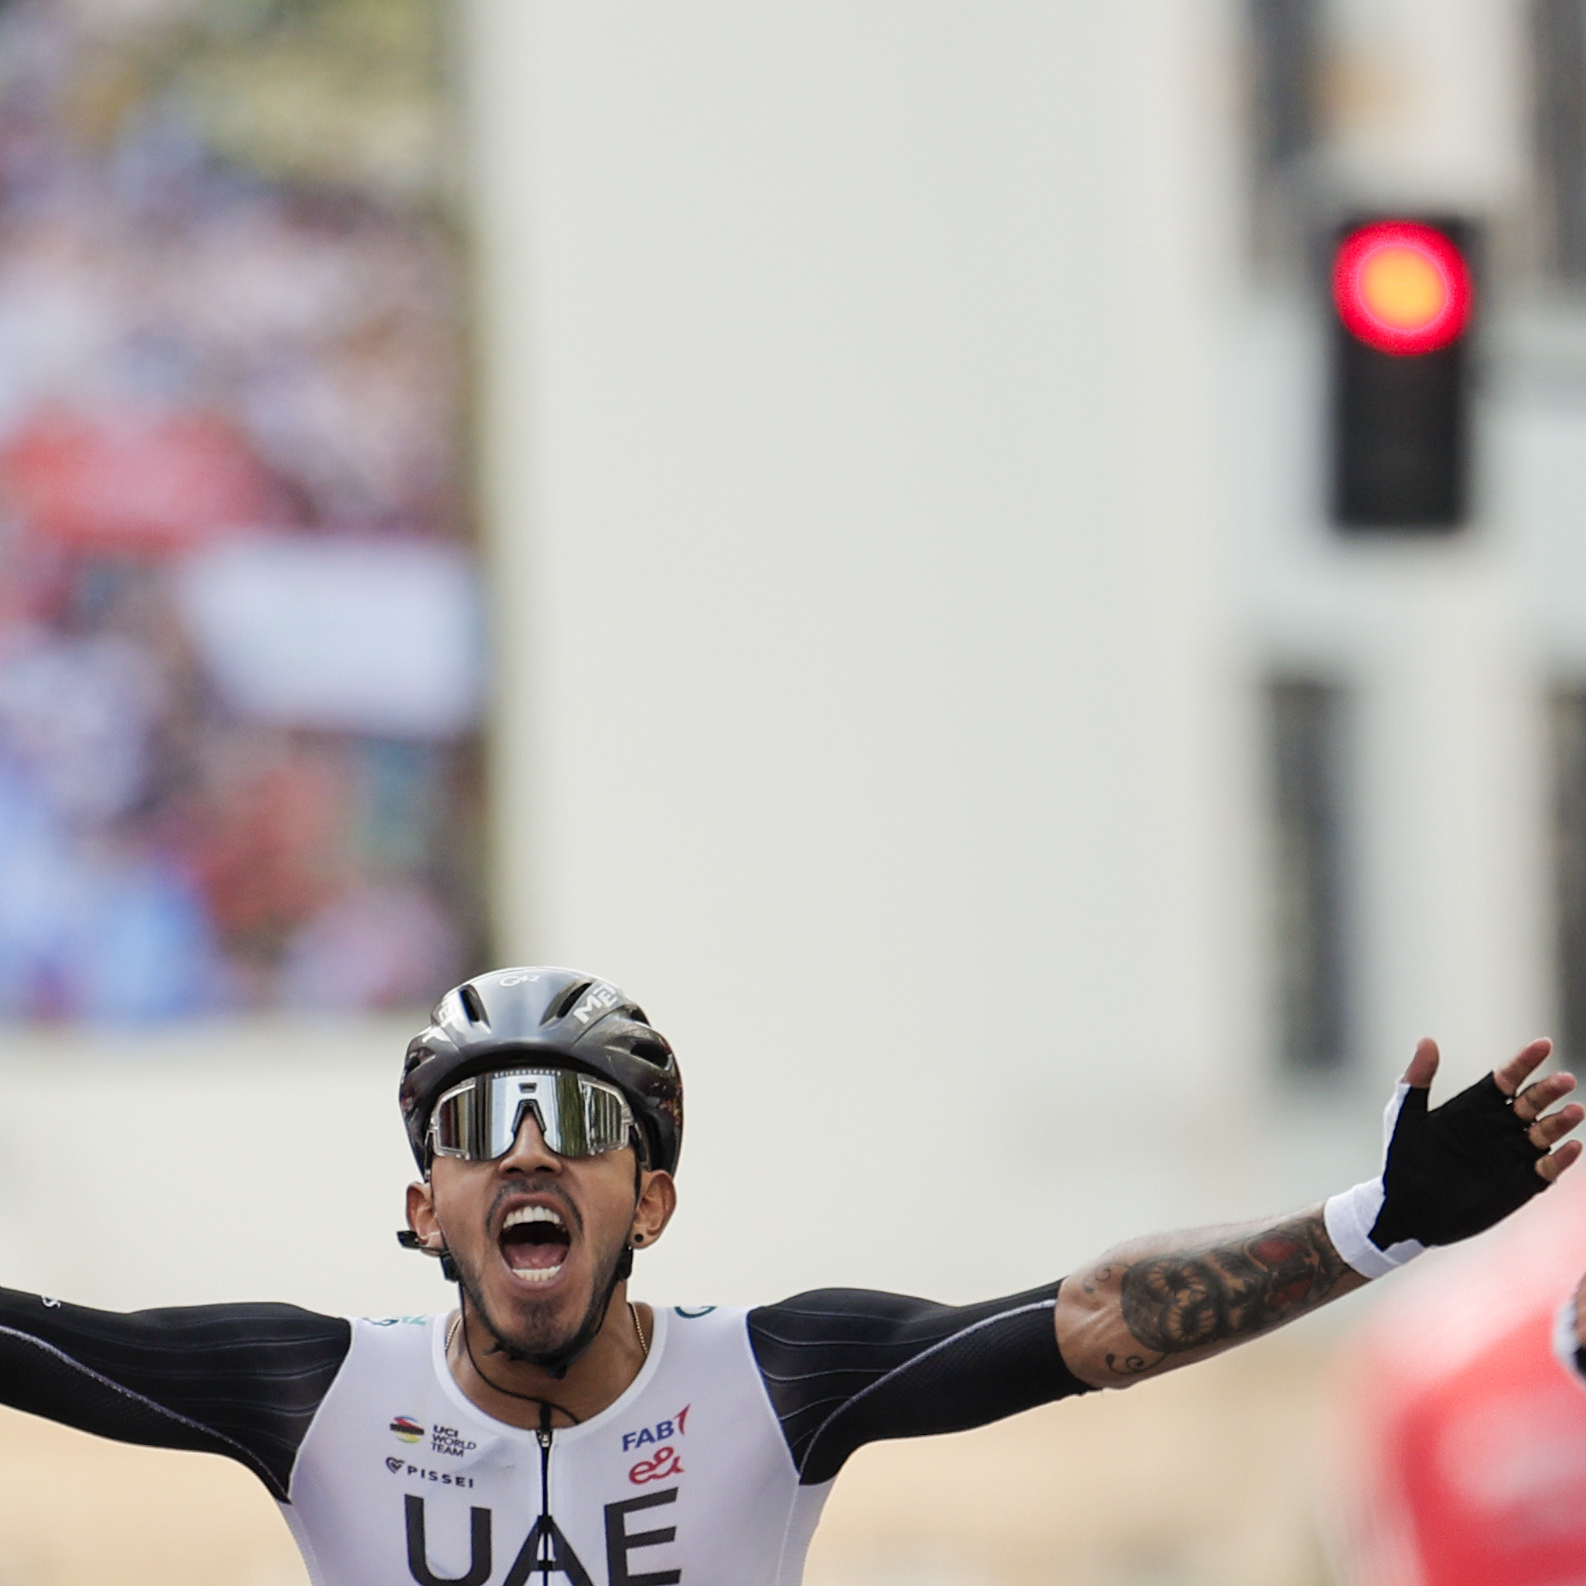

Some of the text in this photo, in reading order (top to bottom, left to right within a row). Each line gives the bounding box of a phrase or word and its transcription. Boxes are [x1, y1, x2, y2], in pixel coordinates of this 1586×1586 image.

[433, 1424, 459, 1438] UCI
[431, 1441, 465, 1458] TEAM
[432, 1433, 477, 1450] WORLD
[407, 1465, 474, 1488] PISSEI
